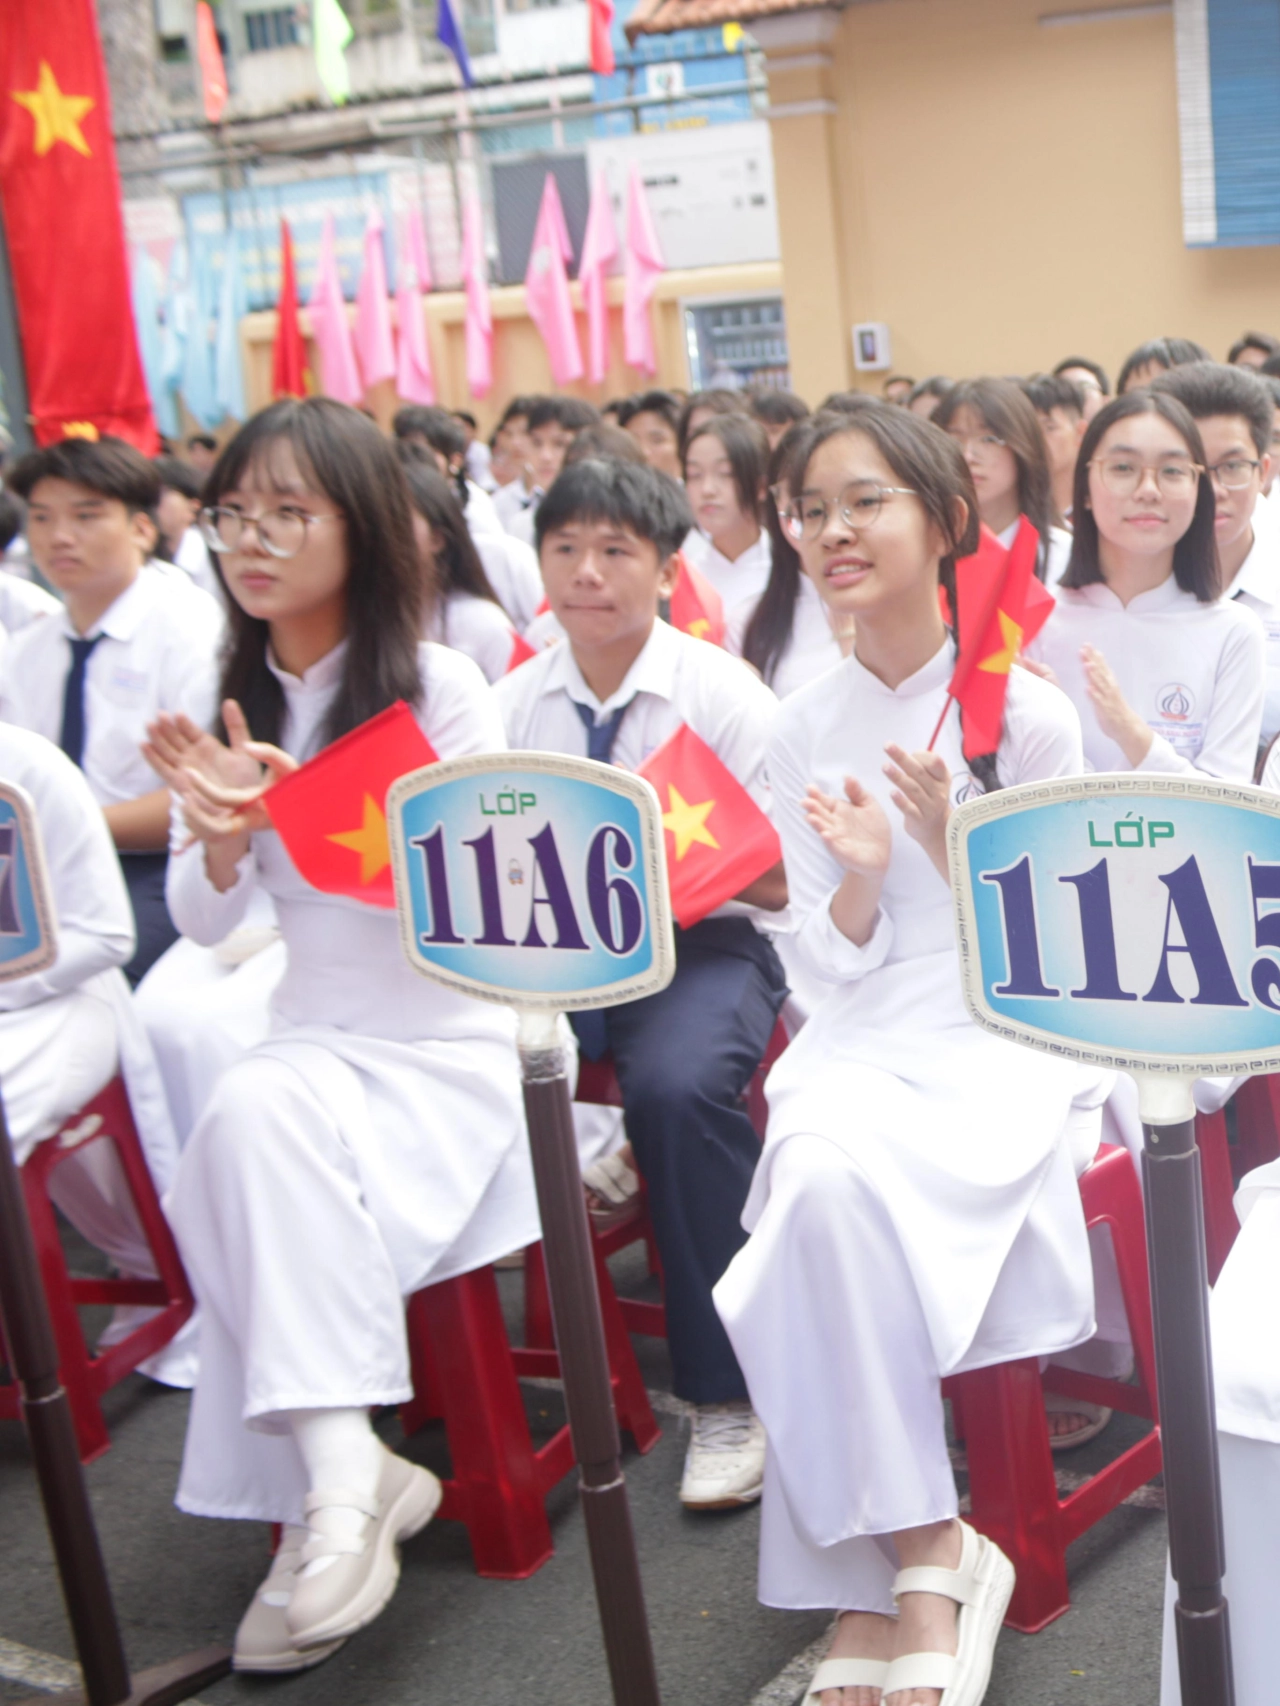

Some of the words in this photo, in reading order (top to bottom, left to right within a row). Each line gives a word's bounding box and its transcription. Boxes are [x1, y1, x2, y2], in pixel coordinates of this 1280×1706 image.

[479, 784, 537, 815] LỚP
[1087, 811, 1175, 848] LỚP
[412, 822, 642, 955] 11A6
